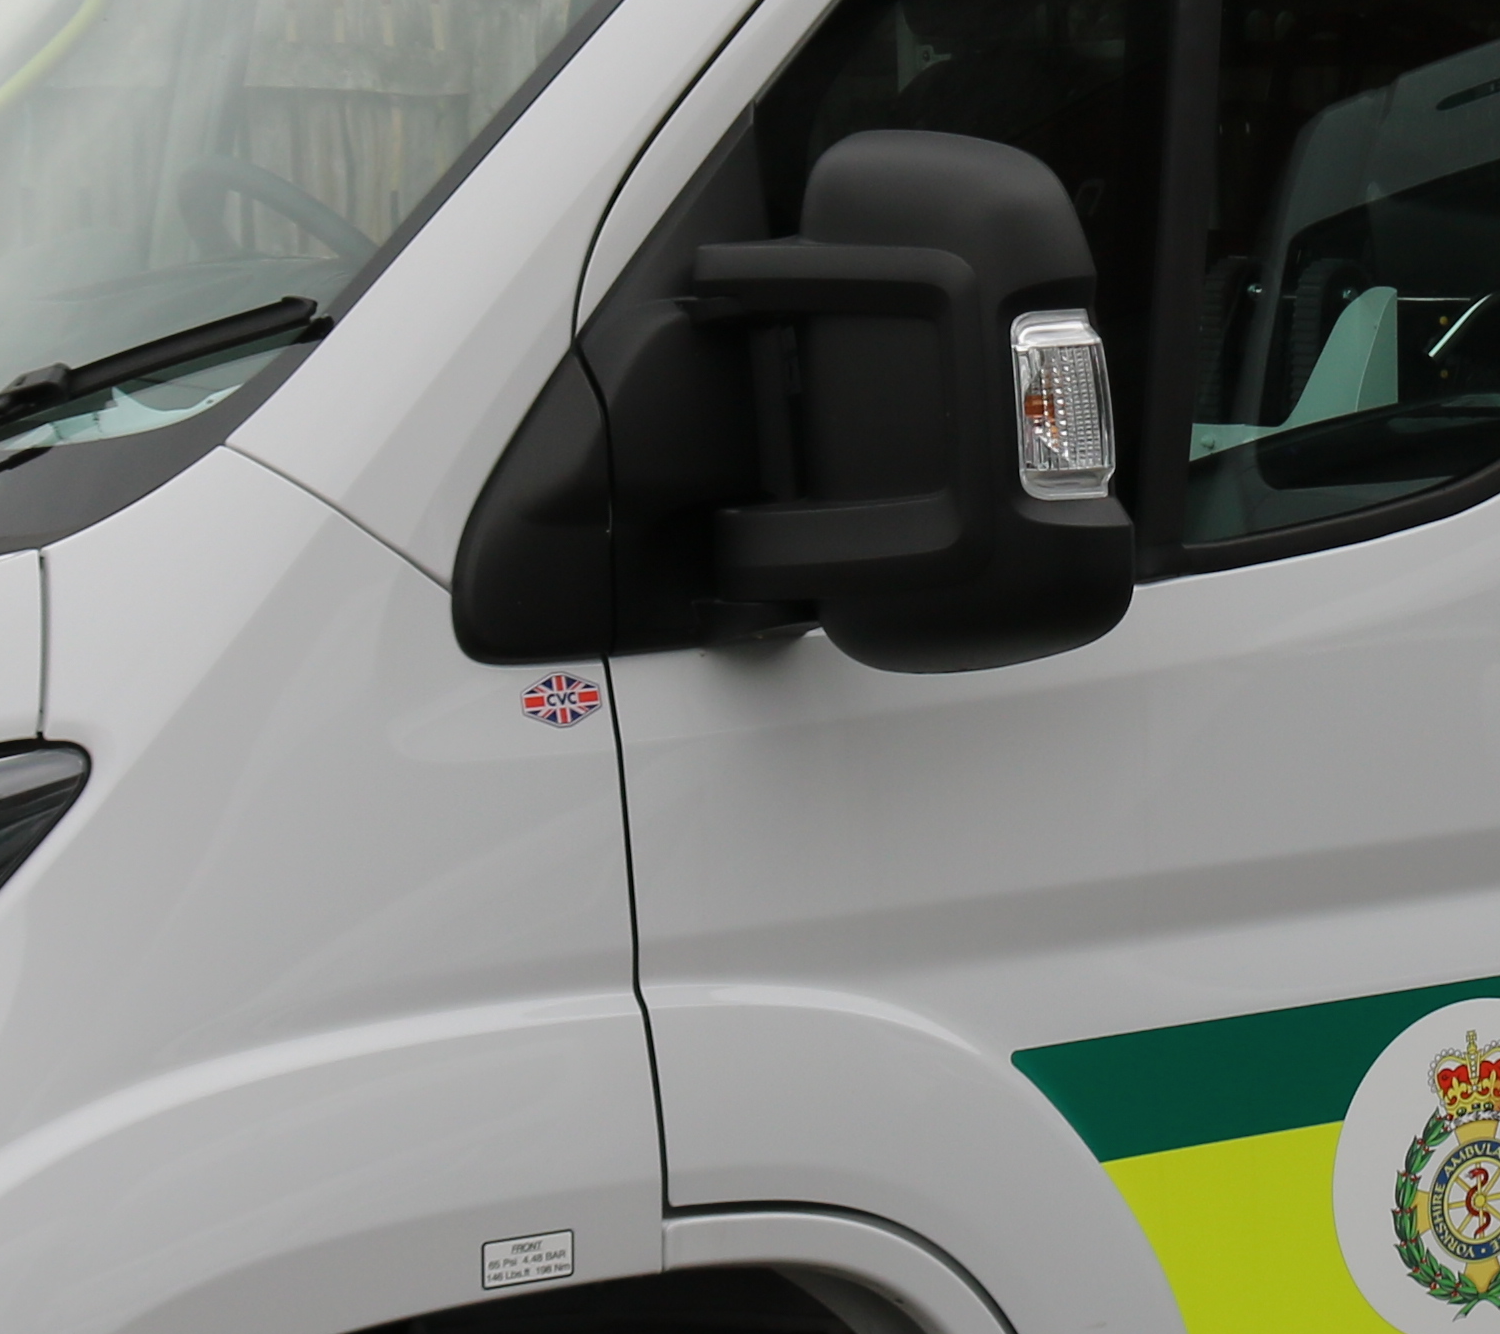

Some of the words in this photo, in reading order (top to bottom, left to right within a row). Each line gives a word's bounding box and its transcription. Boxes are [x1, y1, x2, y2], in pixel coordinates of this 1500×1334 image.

[546, 692, 577, 706] CVC
[1433, 1183, 1476, 1258] YORKSHIRE
[511, 1241, 543, 1254] FRONT
[546, 1250, 566, 1261] BAR
